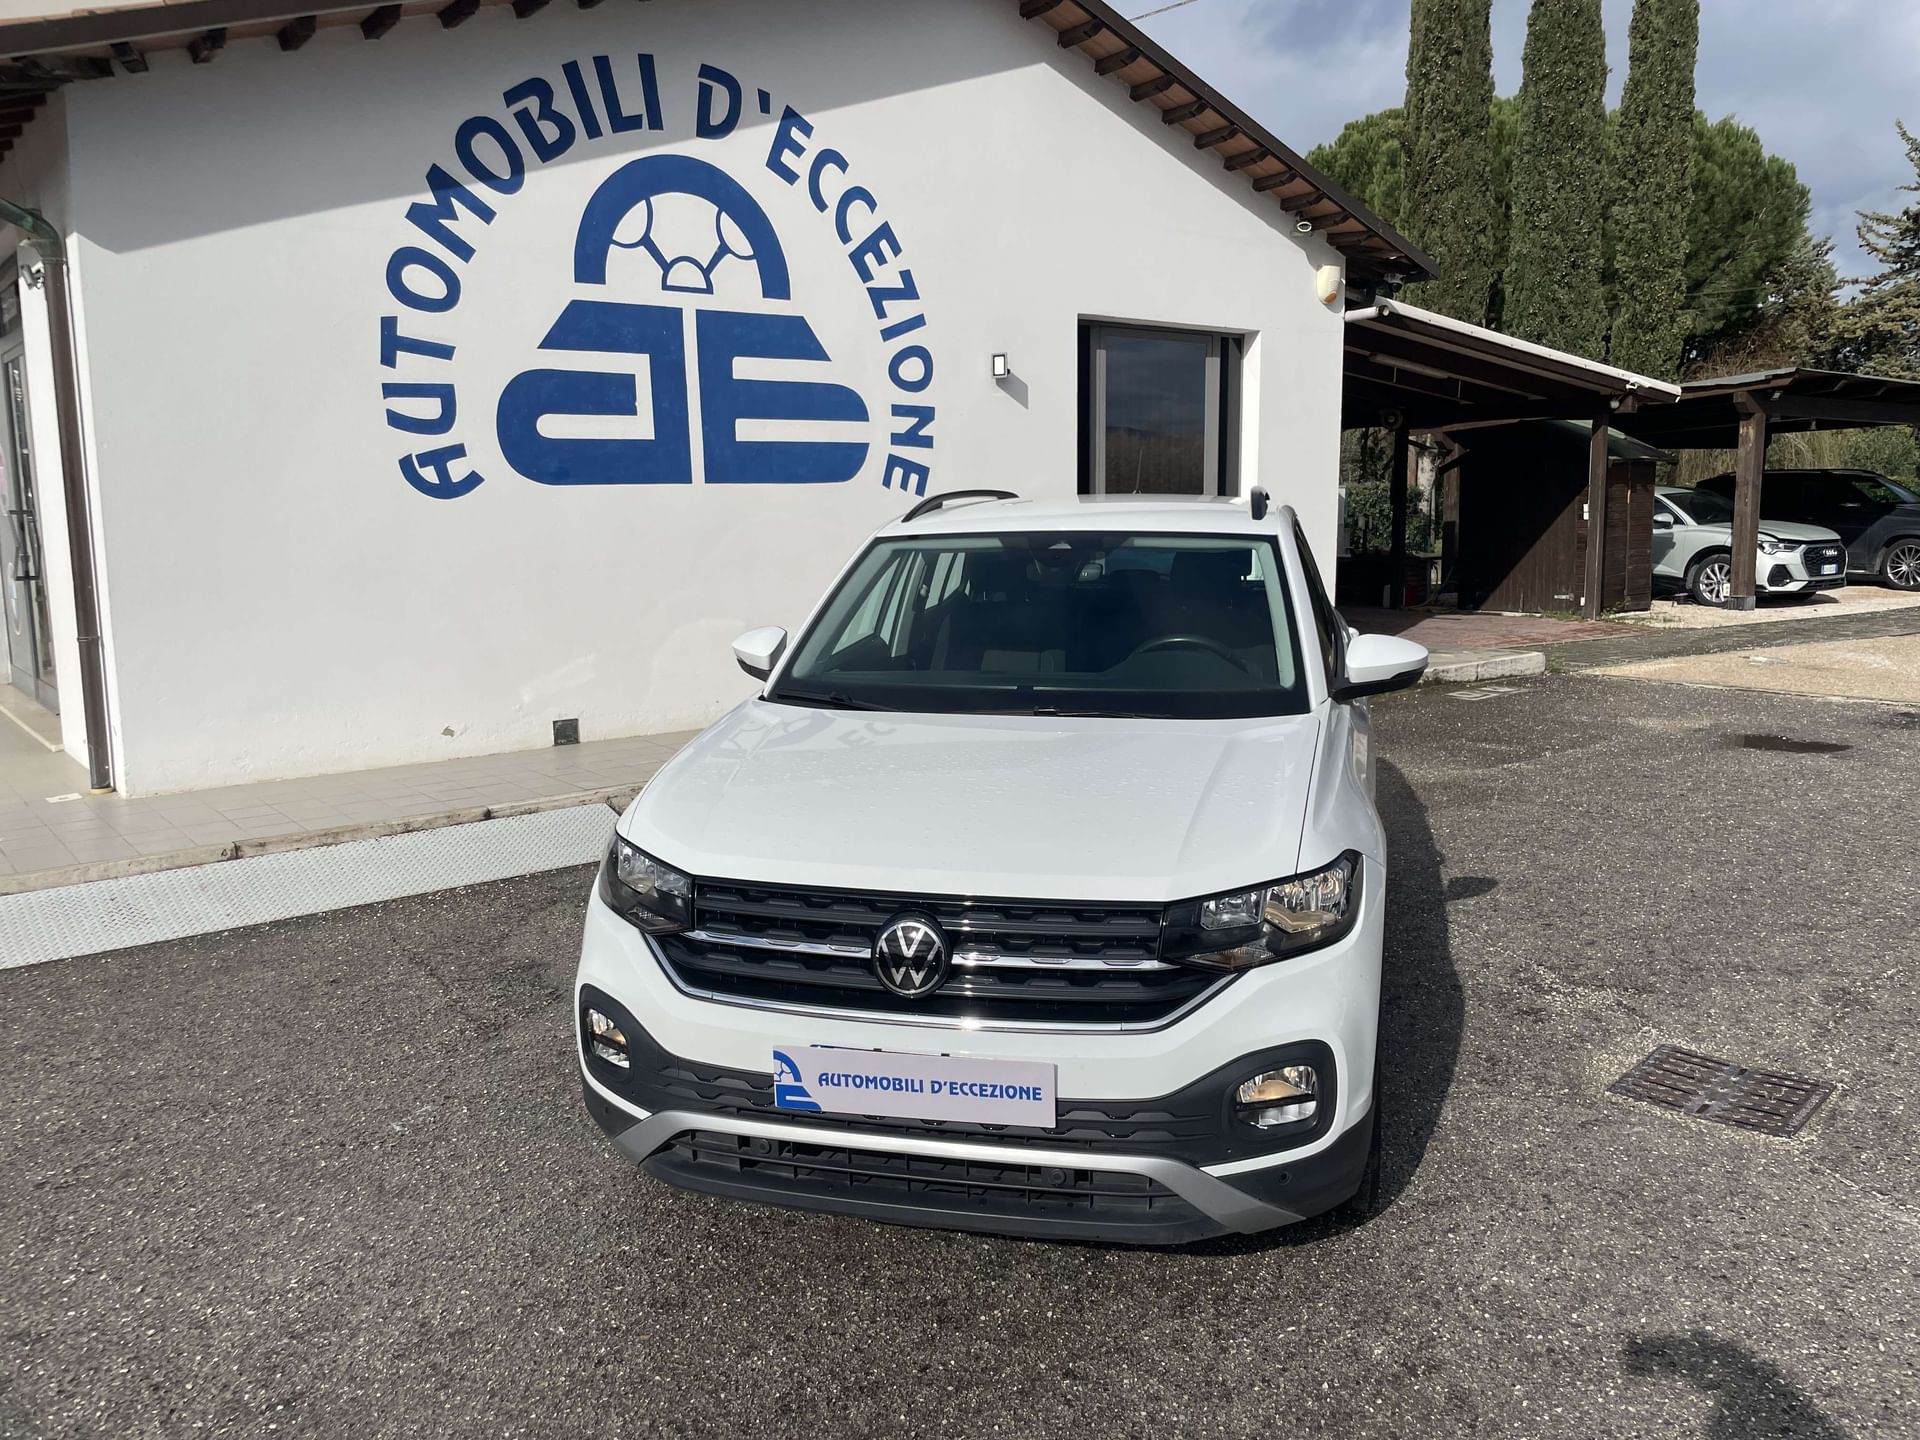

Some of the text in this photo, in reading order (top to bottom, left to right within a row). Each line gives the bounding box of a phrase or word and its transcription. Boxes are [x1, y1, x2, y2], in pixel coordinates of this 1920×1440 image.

[380, 52, 936, 500] AUTOMOBILI D'ECCEZIONE
[818, 1072, 1043, 1101] AUTOMOBILI D'ECCEZIONE
